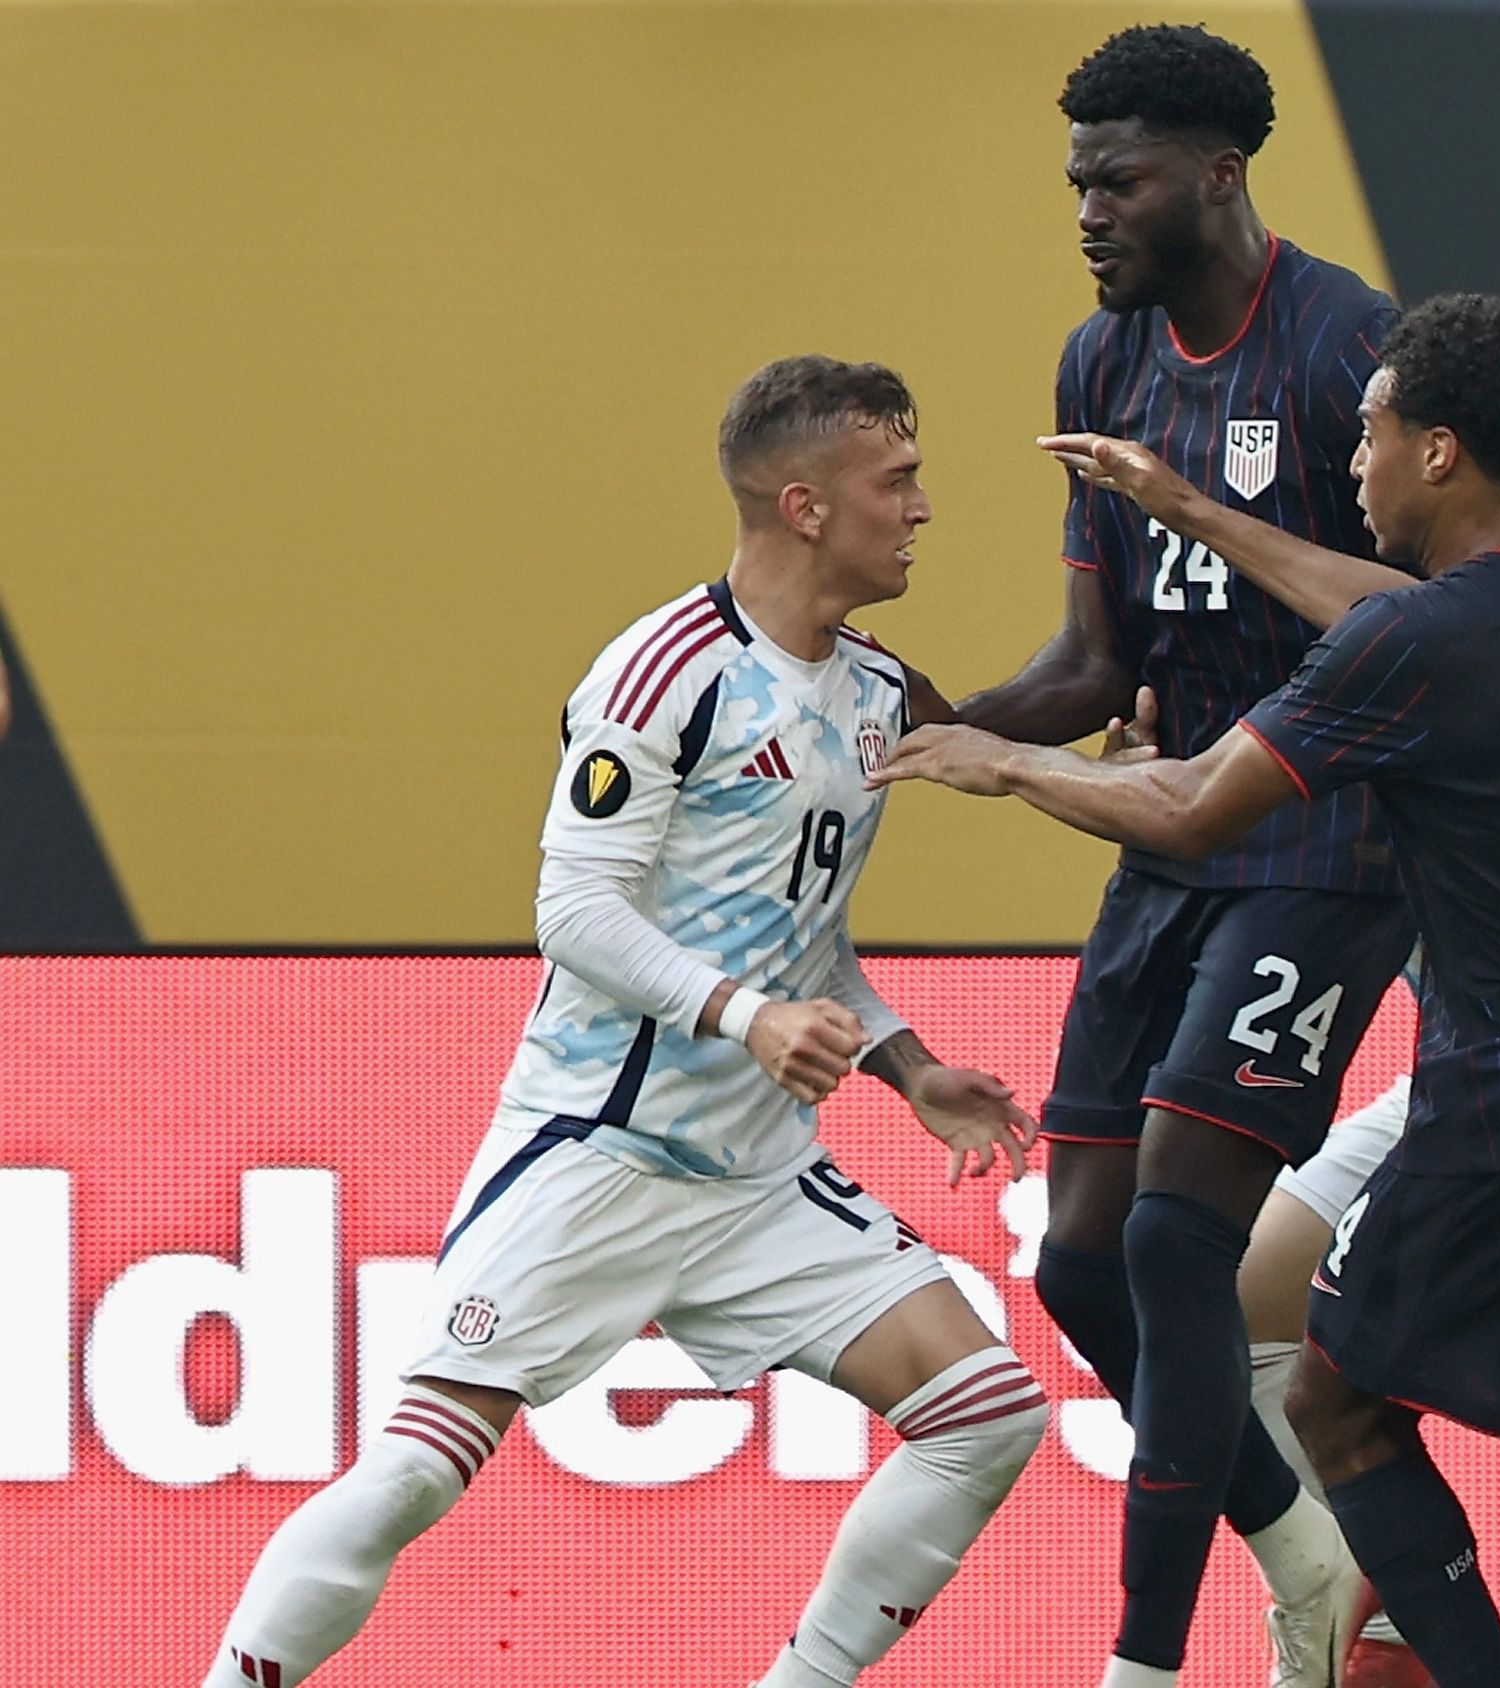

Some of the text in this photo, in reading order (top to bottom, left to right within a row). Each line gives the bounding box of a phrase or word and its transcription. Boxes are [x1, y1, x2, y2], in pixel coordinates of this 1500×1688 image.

[1231, 425, 1274, 453] USA
[1148, 517, 1228, 610] 24
[862, 733, 886, 772] CR
[786, 808, 846, 904] 19
[1228, 954, 1344, 1077] 24
[1327, 1192, 1371, 1278] 4
[457, 1305, 492, 1339] CR
[1445, 1548, 1474, 1581] USA
